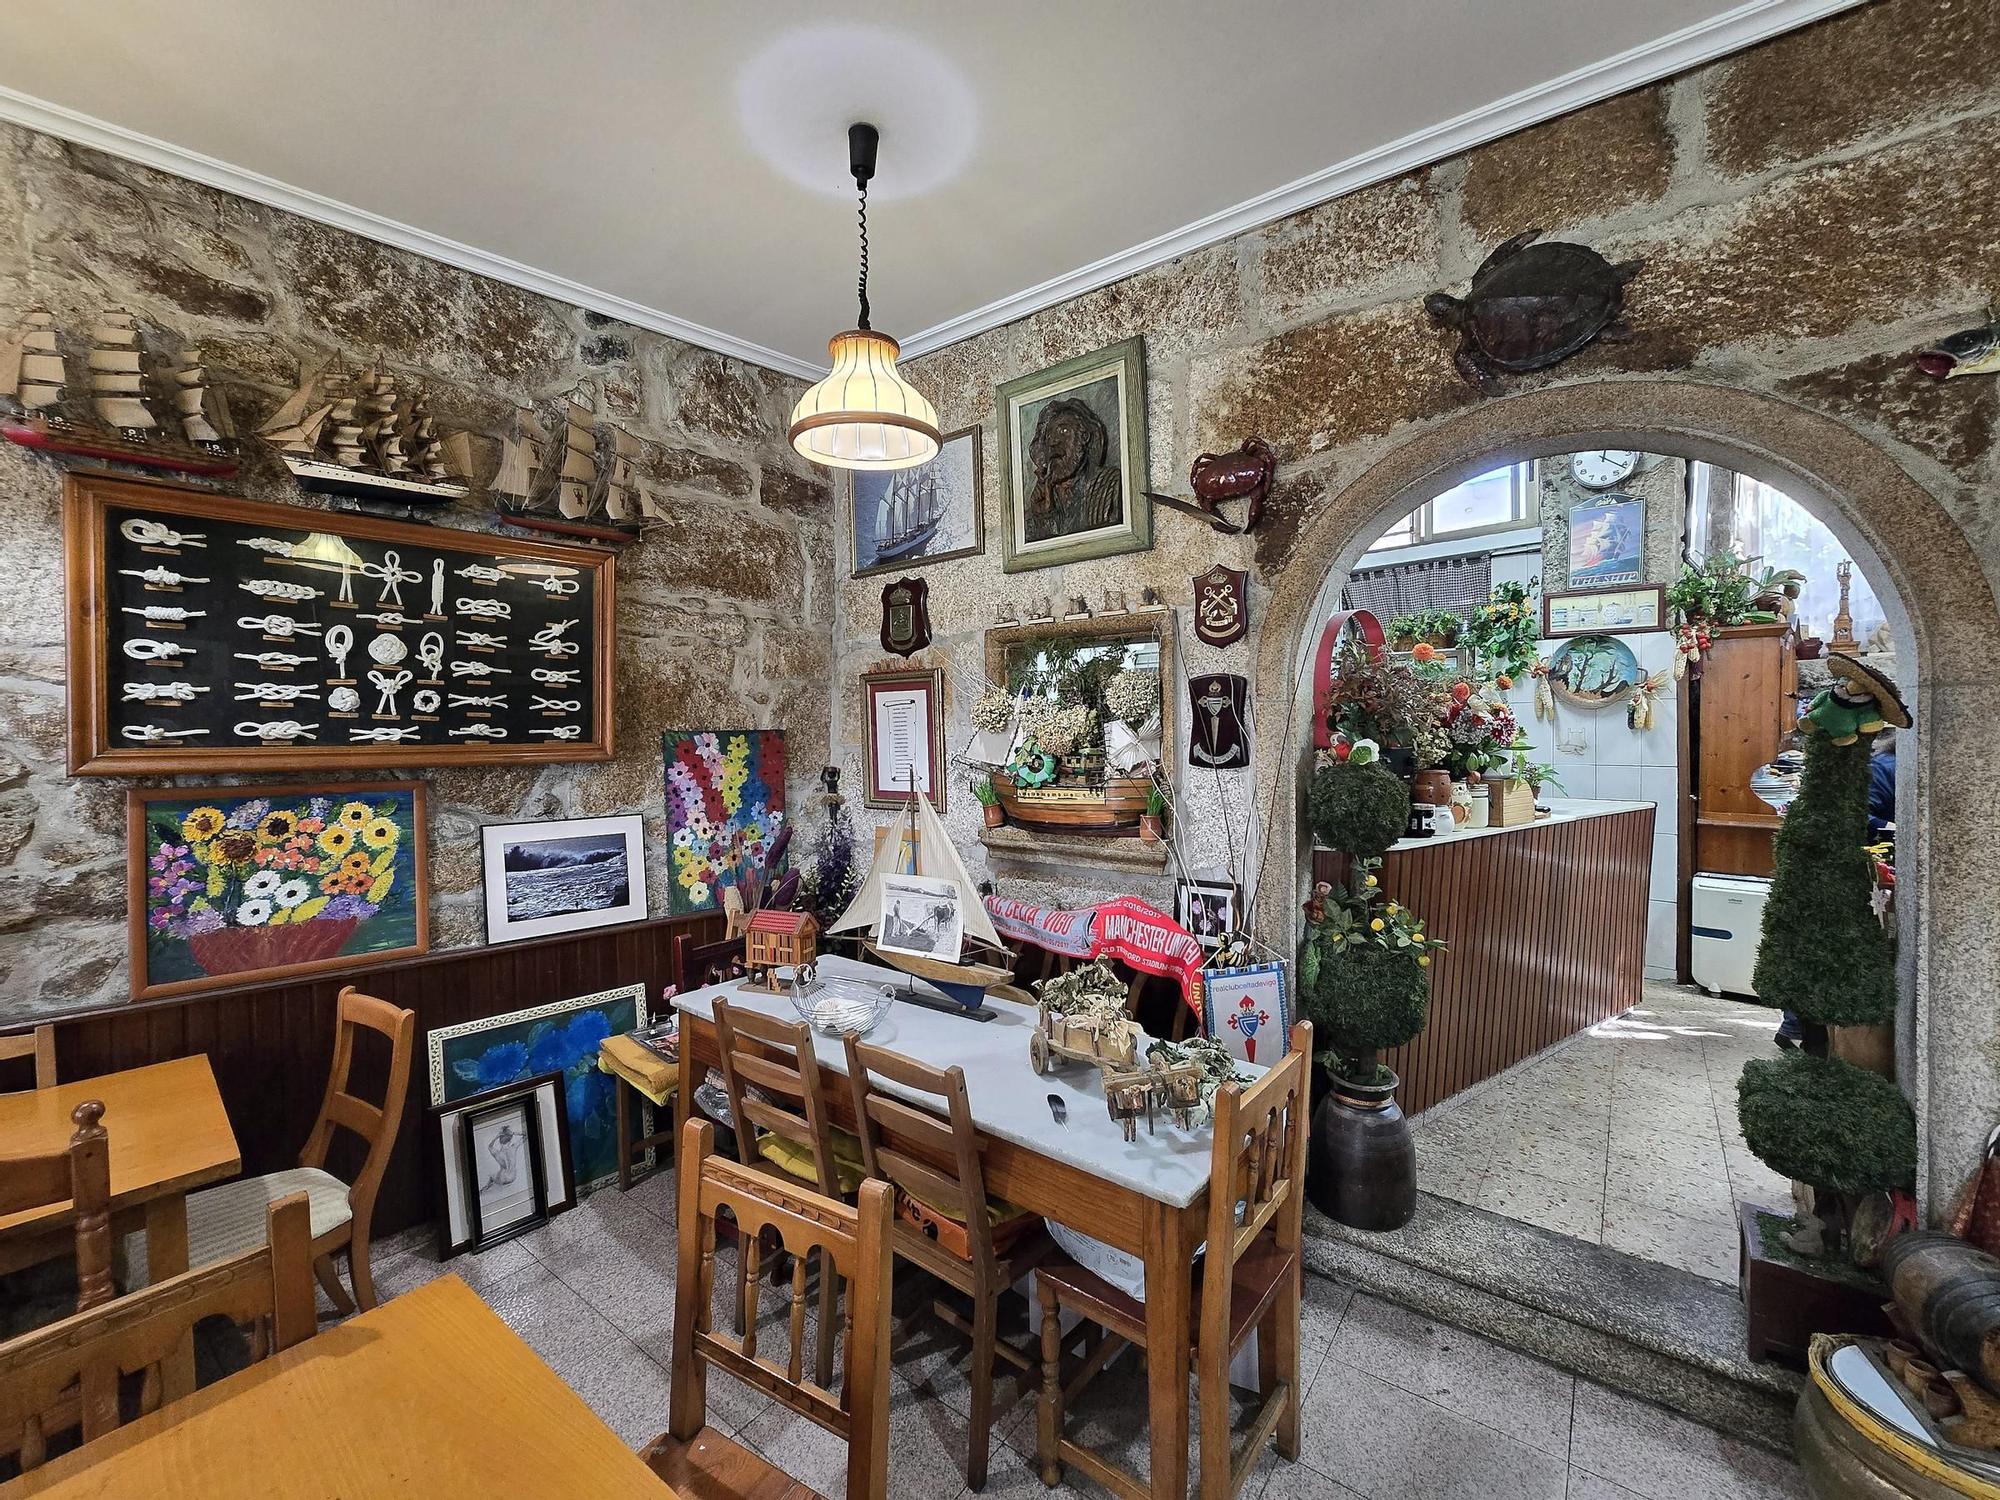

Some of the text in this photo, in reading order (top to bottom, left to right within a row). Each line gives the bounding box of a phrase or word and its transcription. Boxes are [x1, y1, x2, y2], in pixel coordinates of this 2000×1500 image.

[1123, 900, 1162, 919] 2016/2017
[1042, 911, 1076, 936] VIGO
[1101, 945, 1115, 953] OLD
[1105, 914, 1200, 966] MANCHESTER UNITED
